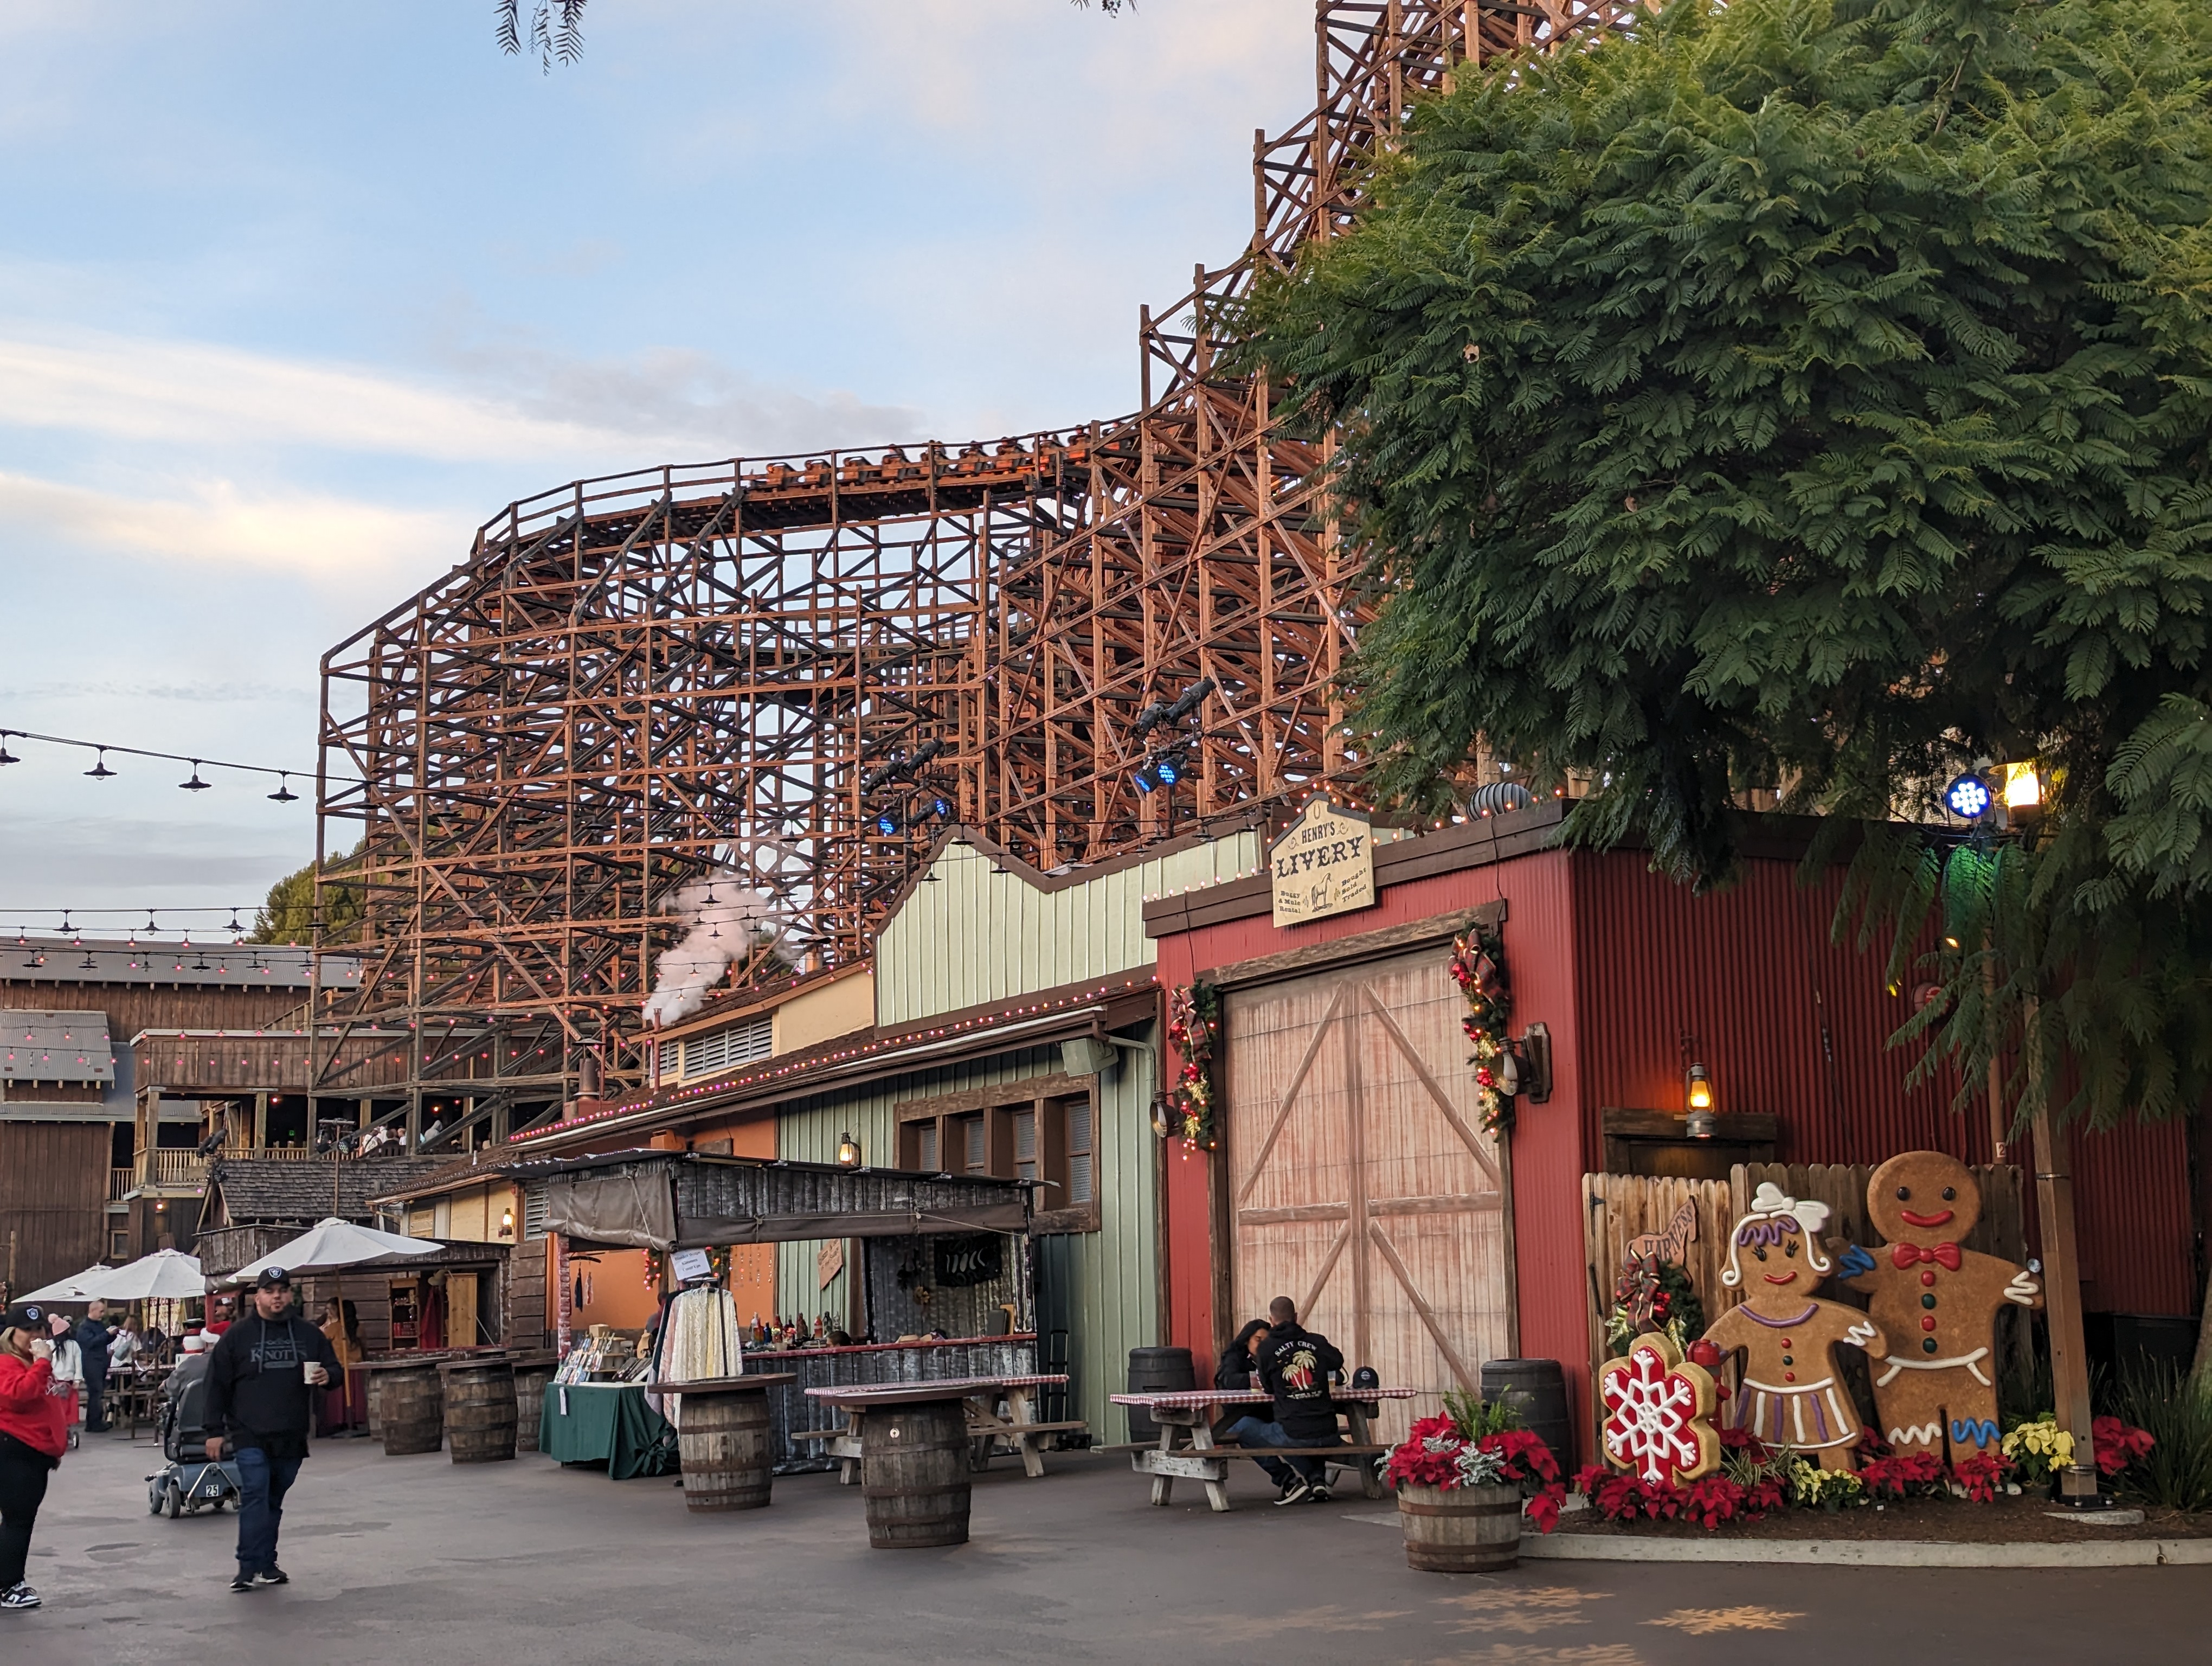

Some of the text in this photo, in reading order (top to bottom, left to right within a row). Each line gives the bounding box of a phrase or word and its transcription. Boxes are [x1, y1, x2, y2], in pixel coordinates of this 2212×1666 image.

[1301, 821, 1335, 844] HENRY'S
[1276, 835, 1365, 879] LIVERY
[1341, 867, 1366, 887] Bought
[1280, 890, 1301, 899] Buggy
[1342, 881, 1357, 895] Sold
[1342, 884, 1366, 902] Traded
[1279, 906, 1301, 914] Rental
[1998, 1144, 2005, 1156] 2
[1644, 1205, 1693, 1263] HARNESS
[1275, 1341, 1317, 1356] SALTY CREW
[207, 1485, 217, 1496] 25
